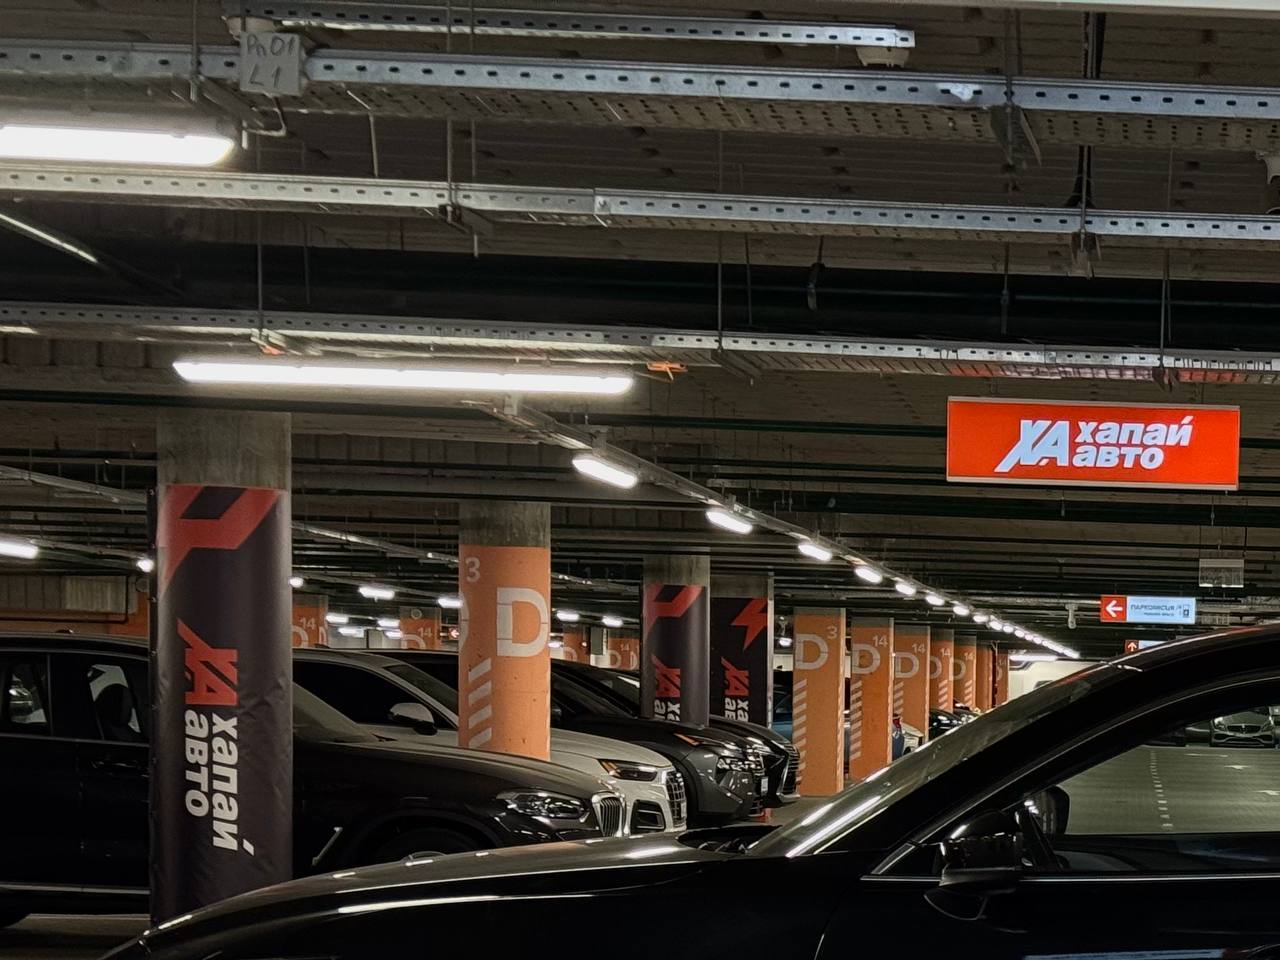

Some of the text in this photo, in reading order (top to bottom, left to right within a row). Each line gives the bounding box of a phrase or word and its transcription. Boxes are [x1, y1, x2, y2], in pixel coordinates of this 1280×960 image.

[1074, 415, 1194, 447] хапай
[1072, 445, 1165, 470] авто
[465, 557, 481, 583] 3
[496, 586, 549, 658] D
[795, 626, 838, 670] D 3
[852, 635, 888, 675] D 14
[895, 643, 926, 679] D 14
[184, 709, 210, 818] авто
